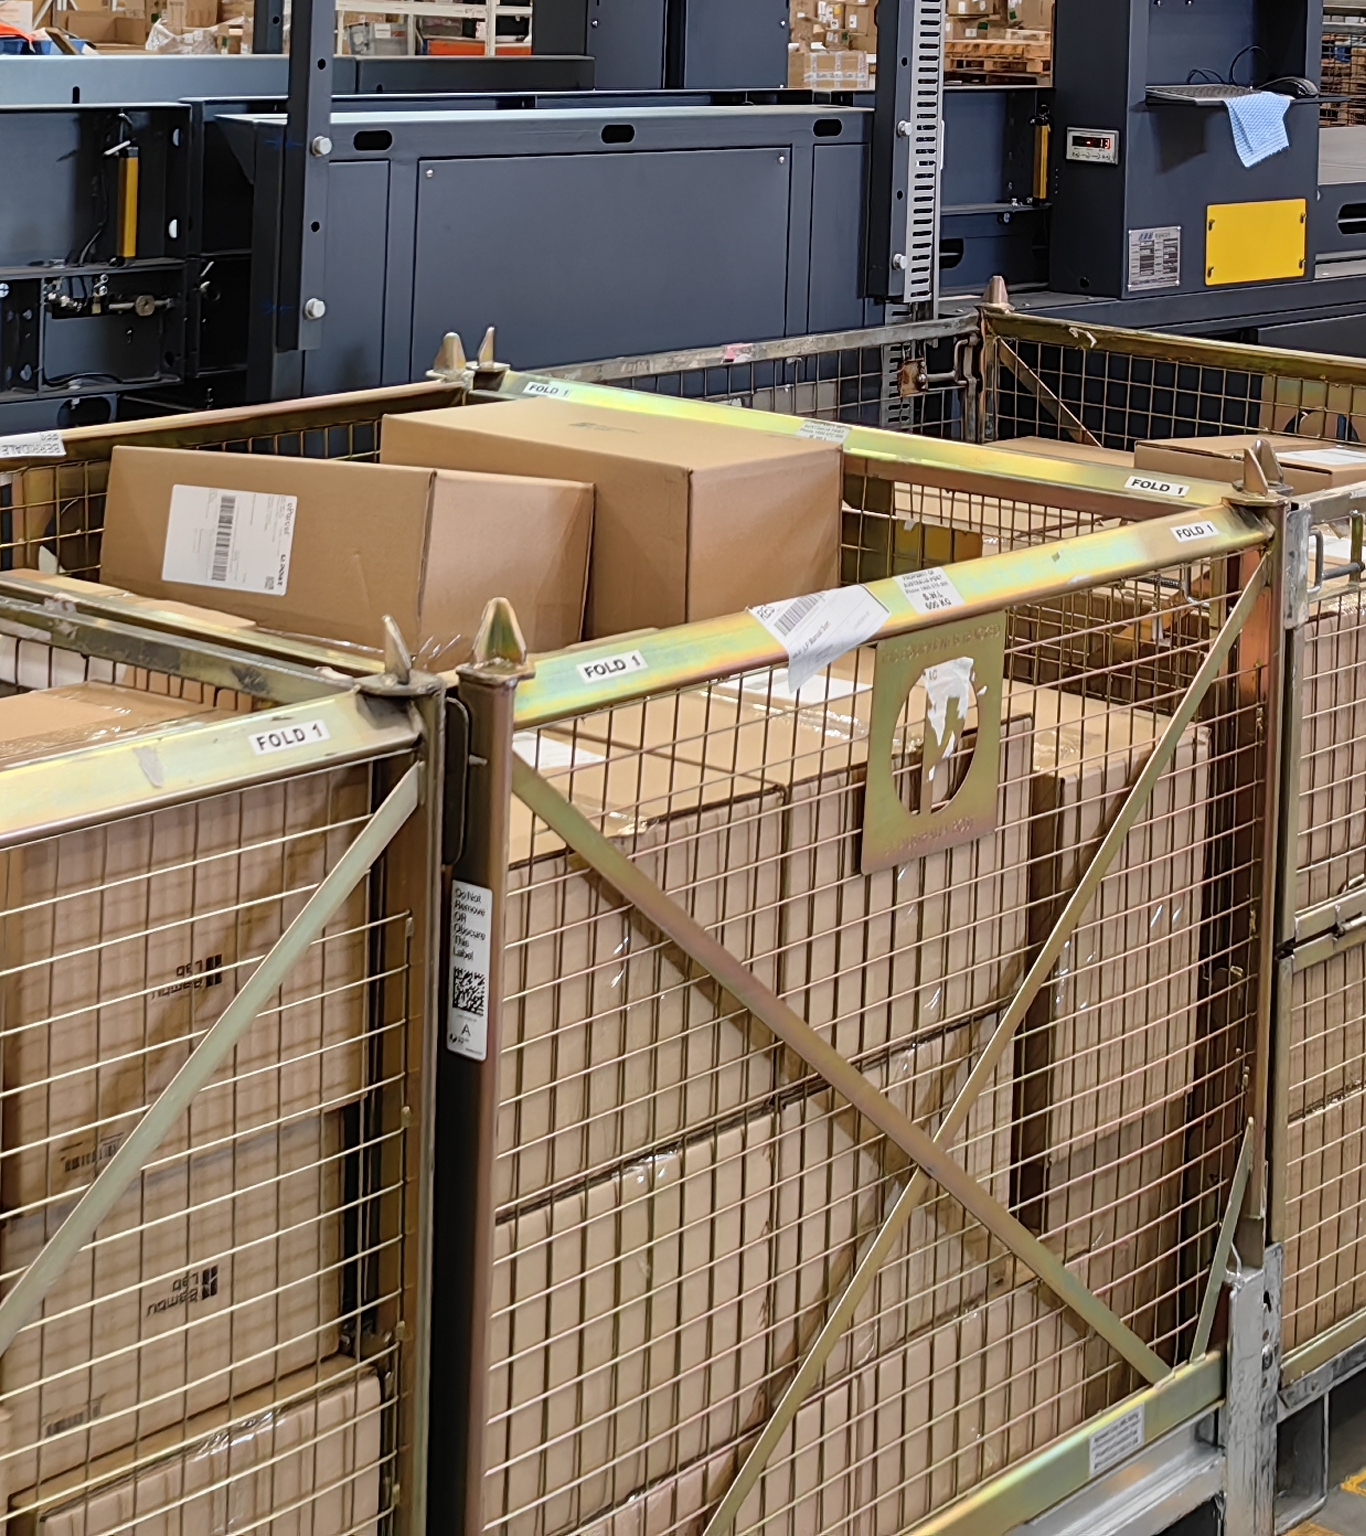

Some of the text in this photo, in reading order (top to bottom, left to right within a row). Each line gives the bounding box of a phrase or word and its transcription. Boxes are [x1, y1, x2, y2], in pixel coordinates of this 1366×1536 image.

[529, 384, 559, 395] FOLD
[1132, 478, 1170, 492] FOLD
[1176, 526, 1204, 539] FOLD
[584, 655, 641, 678] FOLD 1
[256, 724, 323, 751] FOLD 1
[454, 899, 486, 917] Remove
[454, 912, 467, 924] OR
[453, 923, 486, 941] Obscure
[454, 935, 470, 948] This
[453, 945, 474, 961] Label
[461, 1023, 471, 1037] A
[173, 1272, 199, 1292] Lab
[147, 1287, 198, 1318] Bambu
